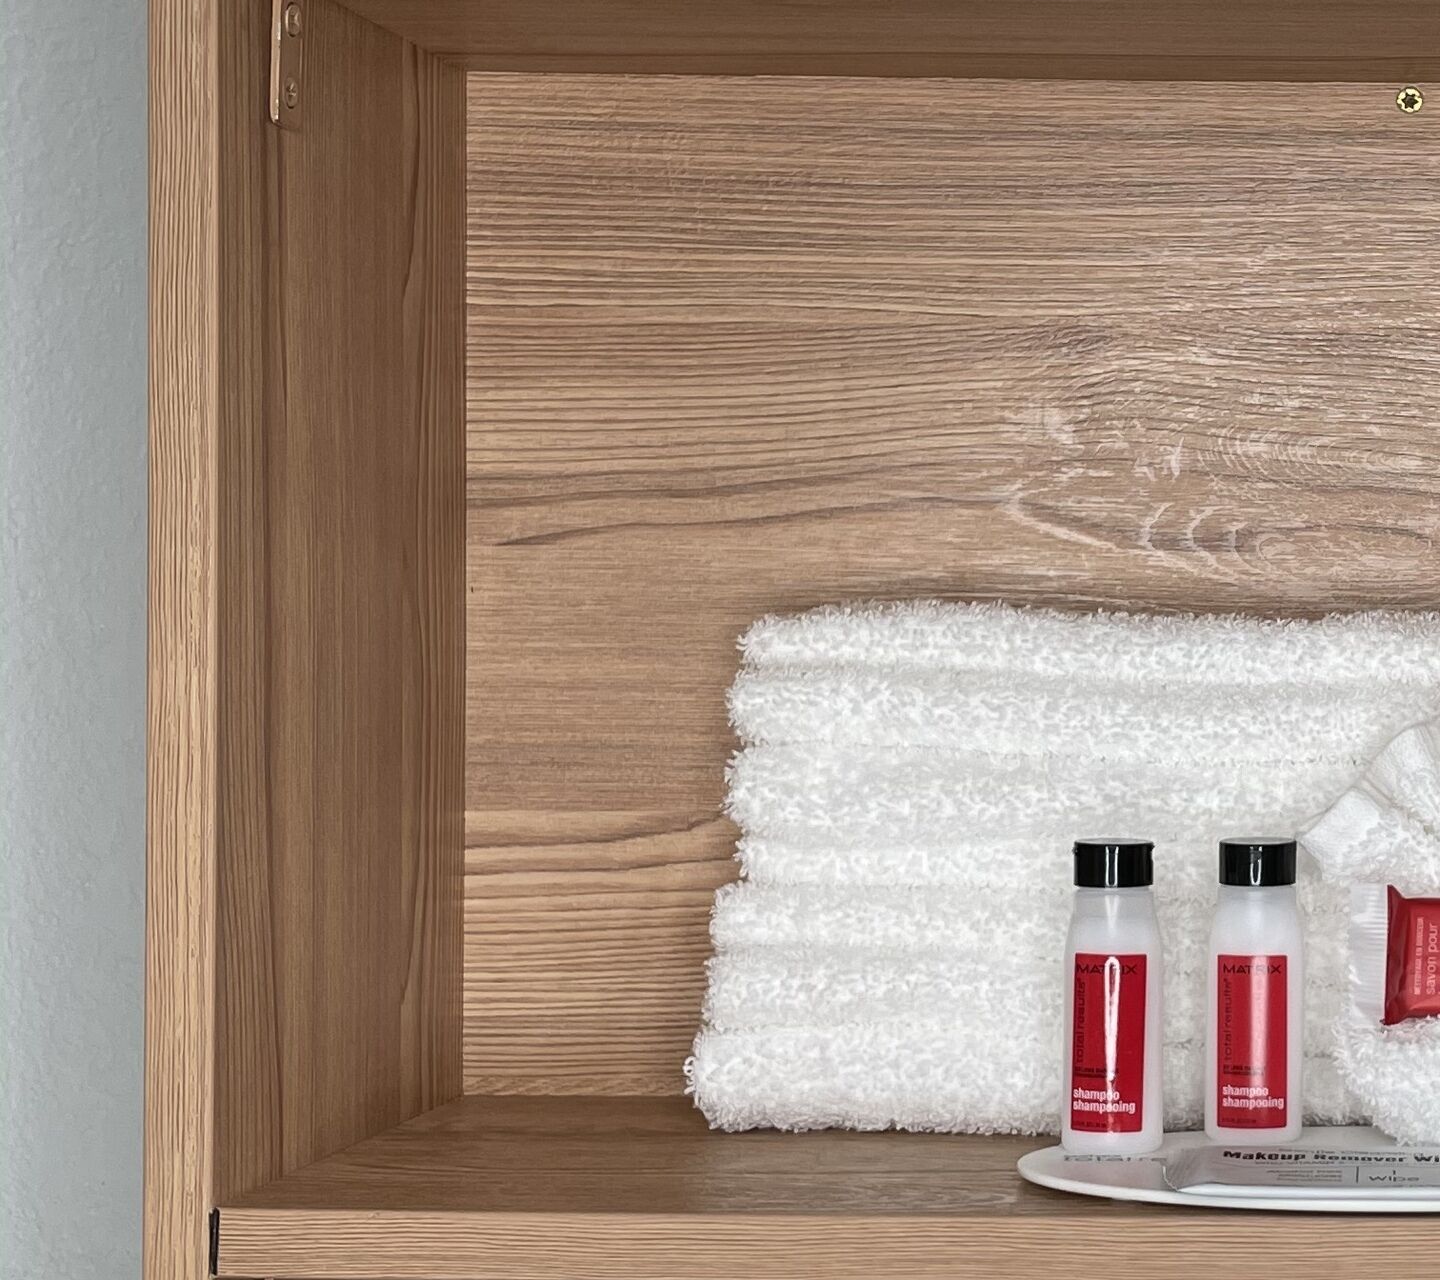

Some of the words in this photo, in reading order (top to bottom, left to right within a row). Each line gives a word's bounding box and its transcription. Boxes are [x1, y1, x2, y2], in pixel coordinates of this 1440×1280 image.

[1427, 922, 1440, 953] pour
[1425, 956, 1437, 995] savon
[1072, 1087, 1121, 1102] shampoo
[1222, 1084, 1269, 1098] shampoo
[1072, 1100, 1136, 1115] shampooing
[1222, 1097, 1285, 1111] shampooing
[1222, 1150, 1306, 1161] Makeup
[1313, 1153, 1407, 1163] Remover
